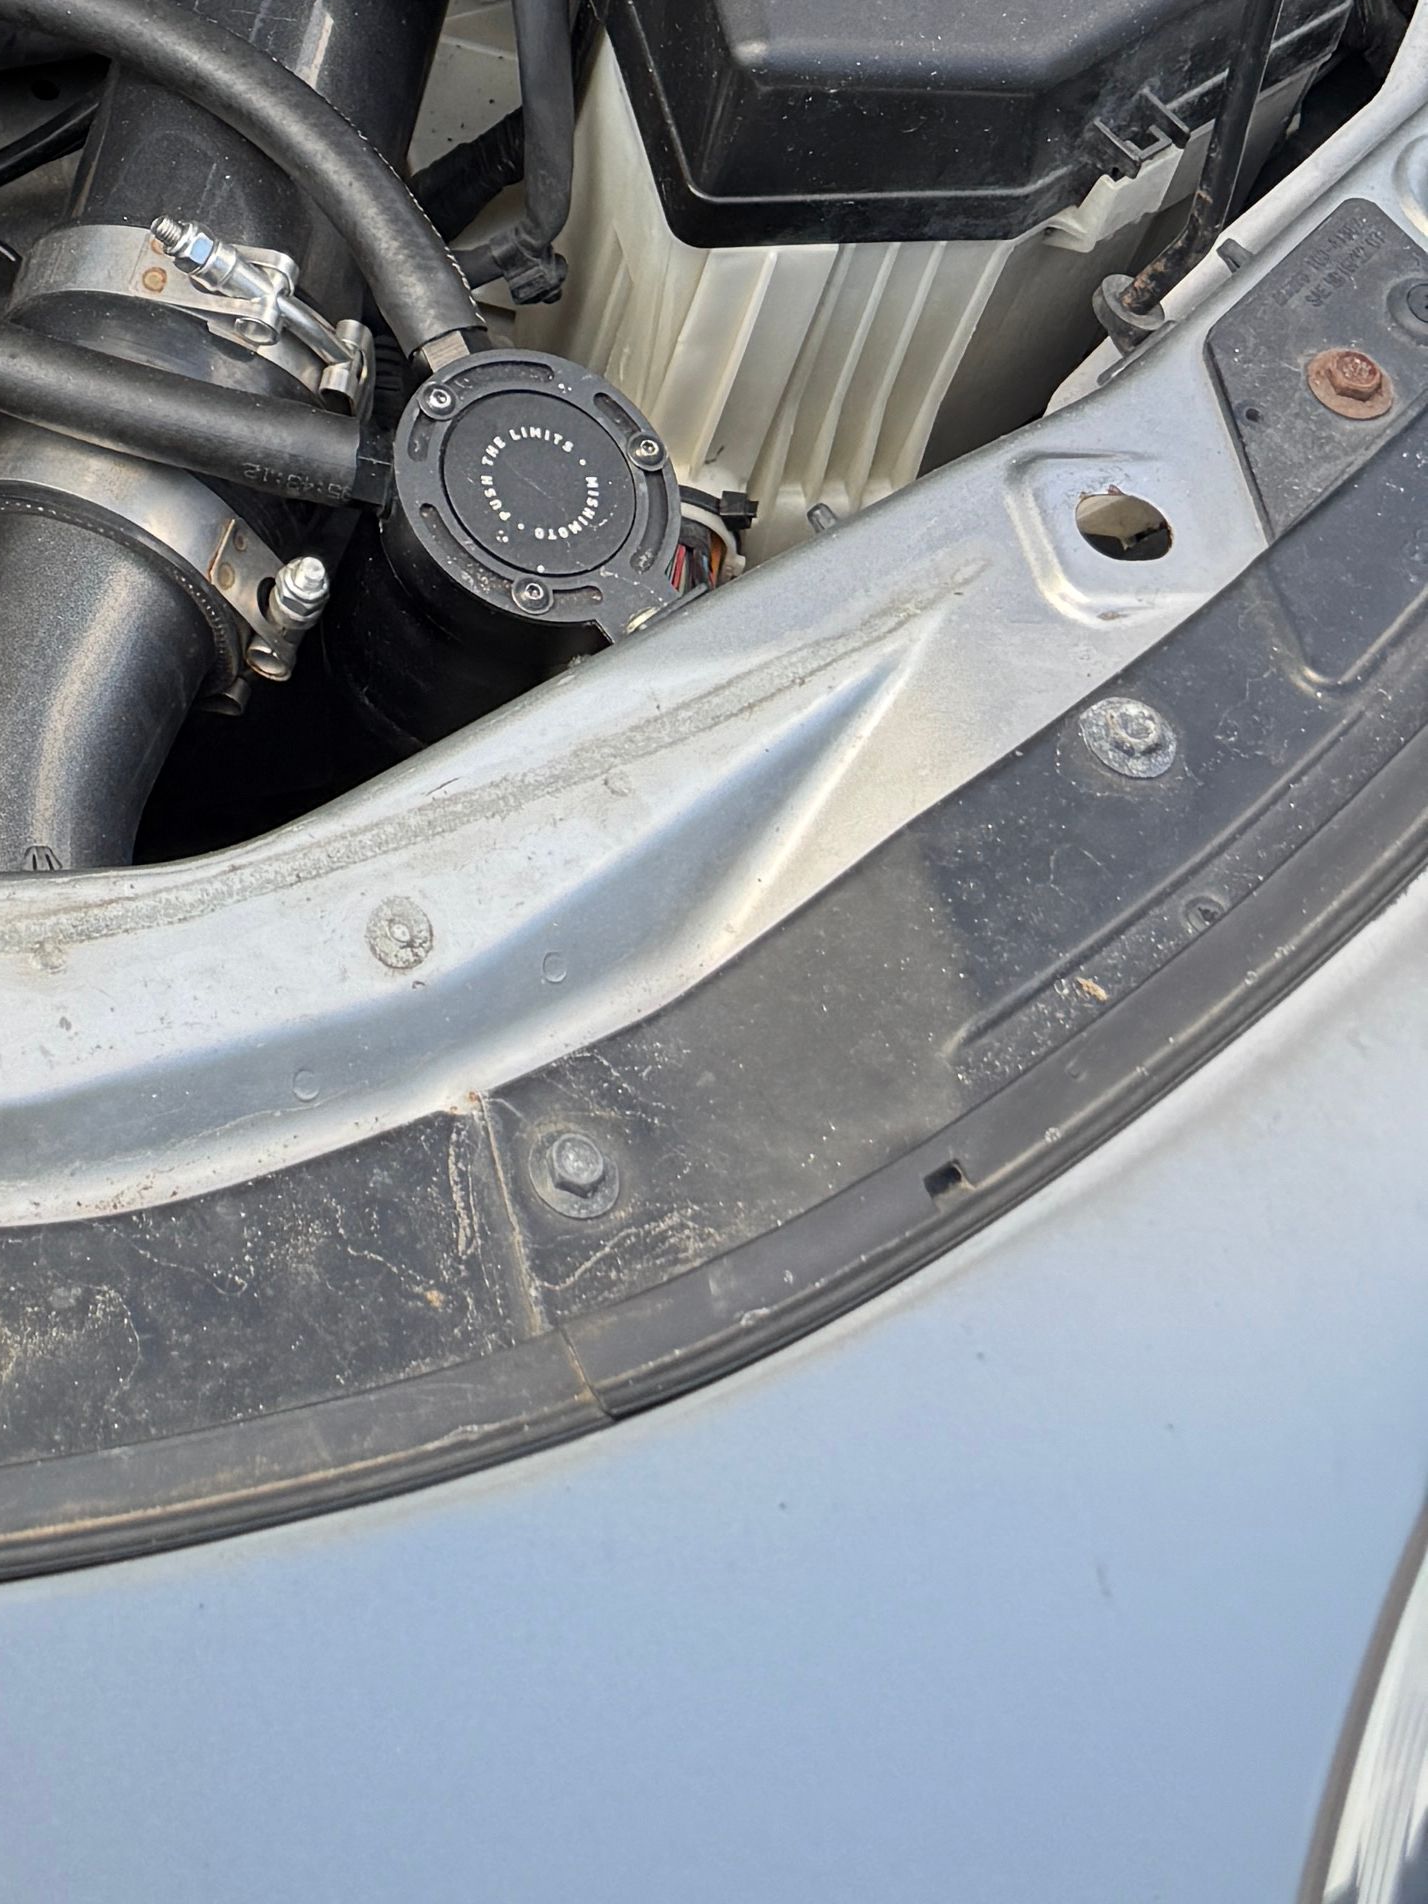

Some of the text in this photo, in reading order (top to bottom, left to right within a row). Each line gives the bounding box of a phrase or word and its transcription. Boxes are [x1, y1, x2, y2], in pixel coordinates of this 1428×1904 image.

[480, 426, 575, 522] PUSH THE LIMITS
[534, 476, 600, 541] MISHIMOTO
